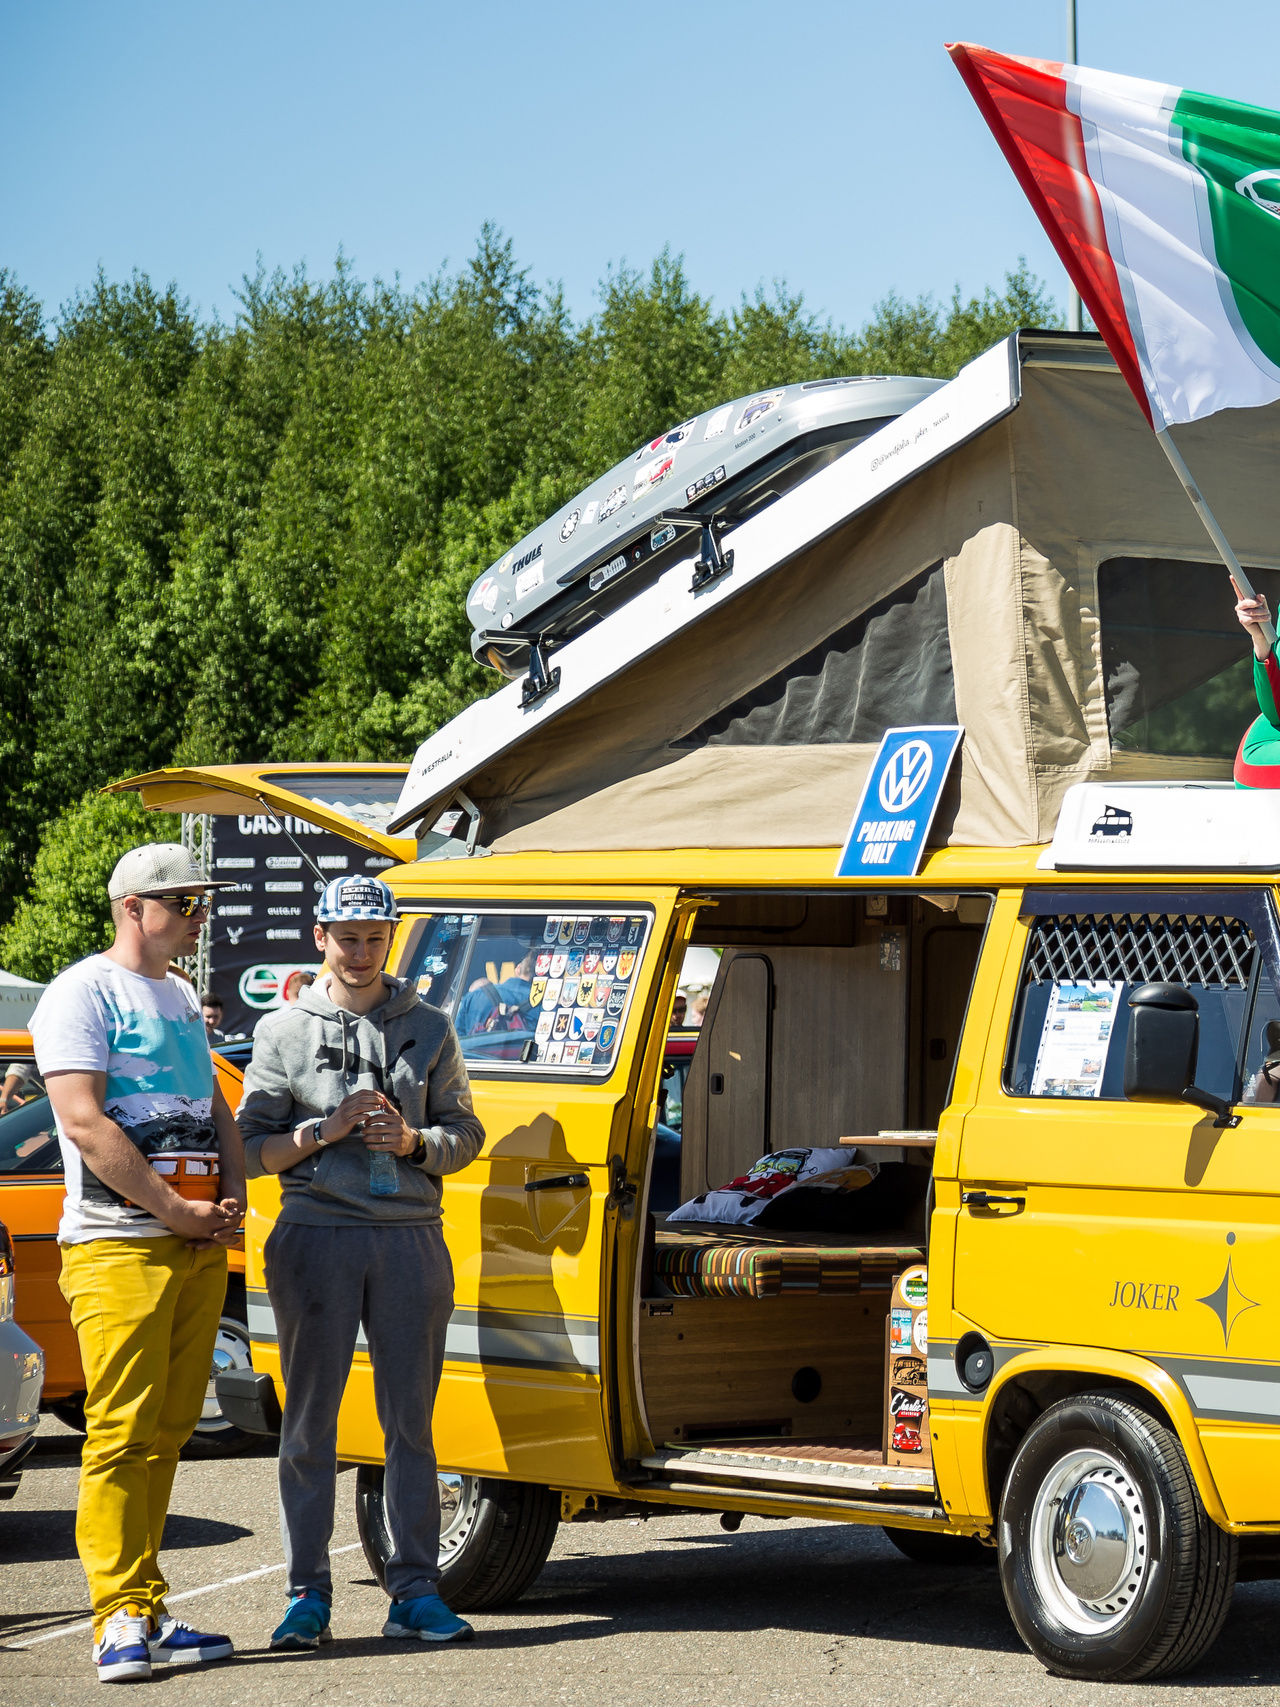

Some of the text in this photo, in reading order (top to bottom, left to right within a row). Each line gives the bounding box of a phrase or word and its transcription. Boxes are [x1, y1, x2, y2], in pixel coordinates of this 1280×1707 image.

[511, 543, 543, 575] THULE
[421, 750, 453, 777] WESTFALIA
[857, 820, 916, 842] PARKING
[861, 843, 897, 864] ONLY
[1109, 1281, 1179, 1311] JOKER
[890, 1392, 927, 1416] Charlie's
